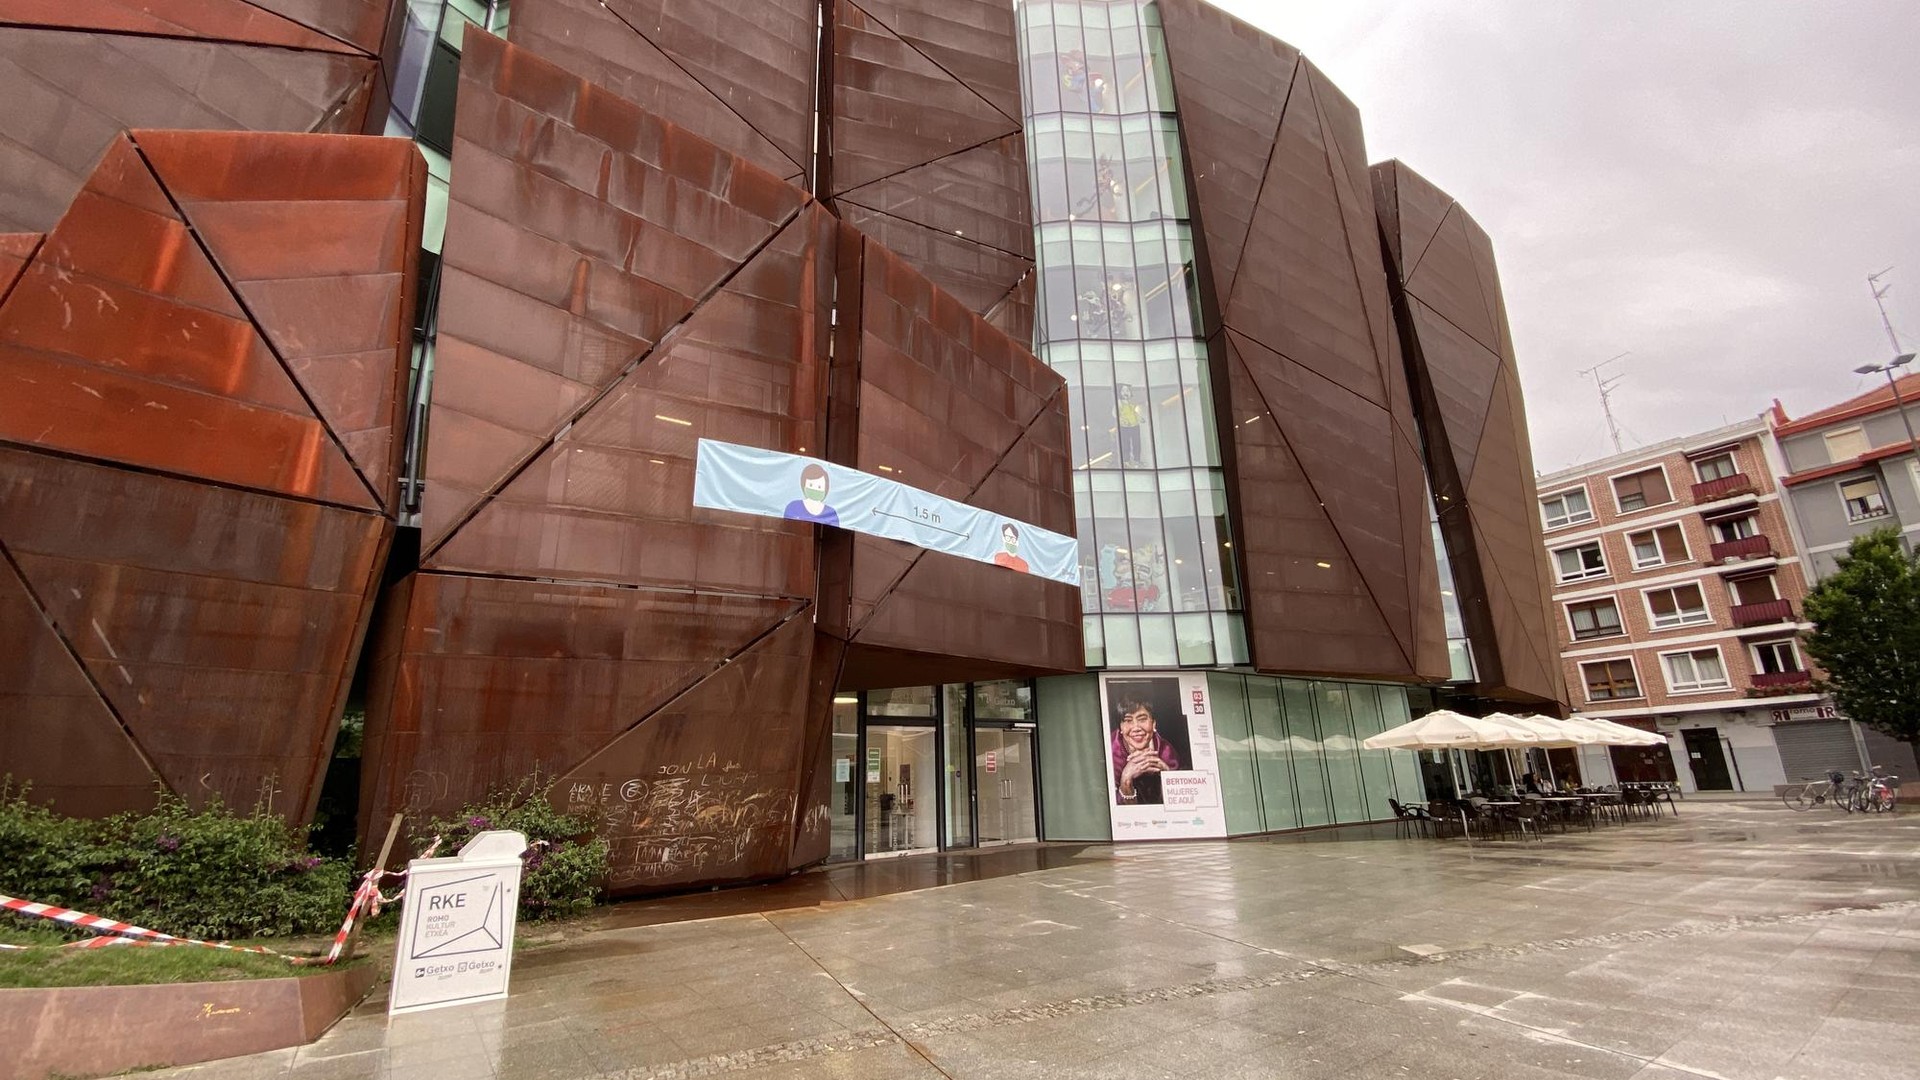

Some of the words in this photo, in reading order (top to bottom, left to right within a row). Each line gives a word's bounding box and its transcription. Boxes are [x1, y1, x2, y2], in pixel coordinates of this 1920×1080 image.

[913, 506, 929, 520] 1.5
[931, 513, 941, 523] m
[1166, 777, 1207, 786] BERTOKOAK
[1167, 787, 1199, 796] MUJERES
[1168, 797, 1179, 805] DE
[429, 893, 467, 910] RKE
[427, 914, 449, 922] ROMO
[426, 921, 456, 930] KULTUR
[425, 929, 449, 938] ETXEA
[426, 963, 454, 974] Getxo
[468, 960, 495, 970] Getxo
